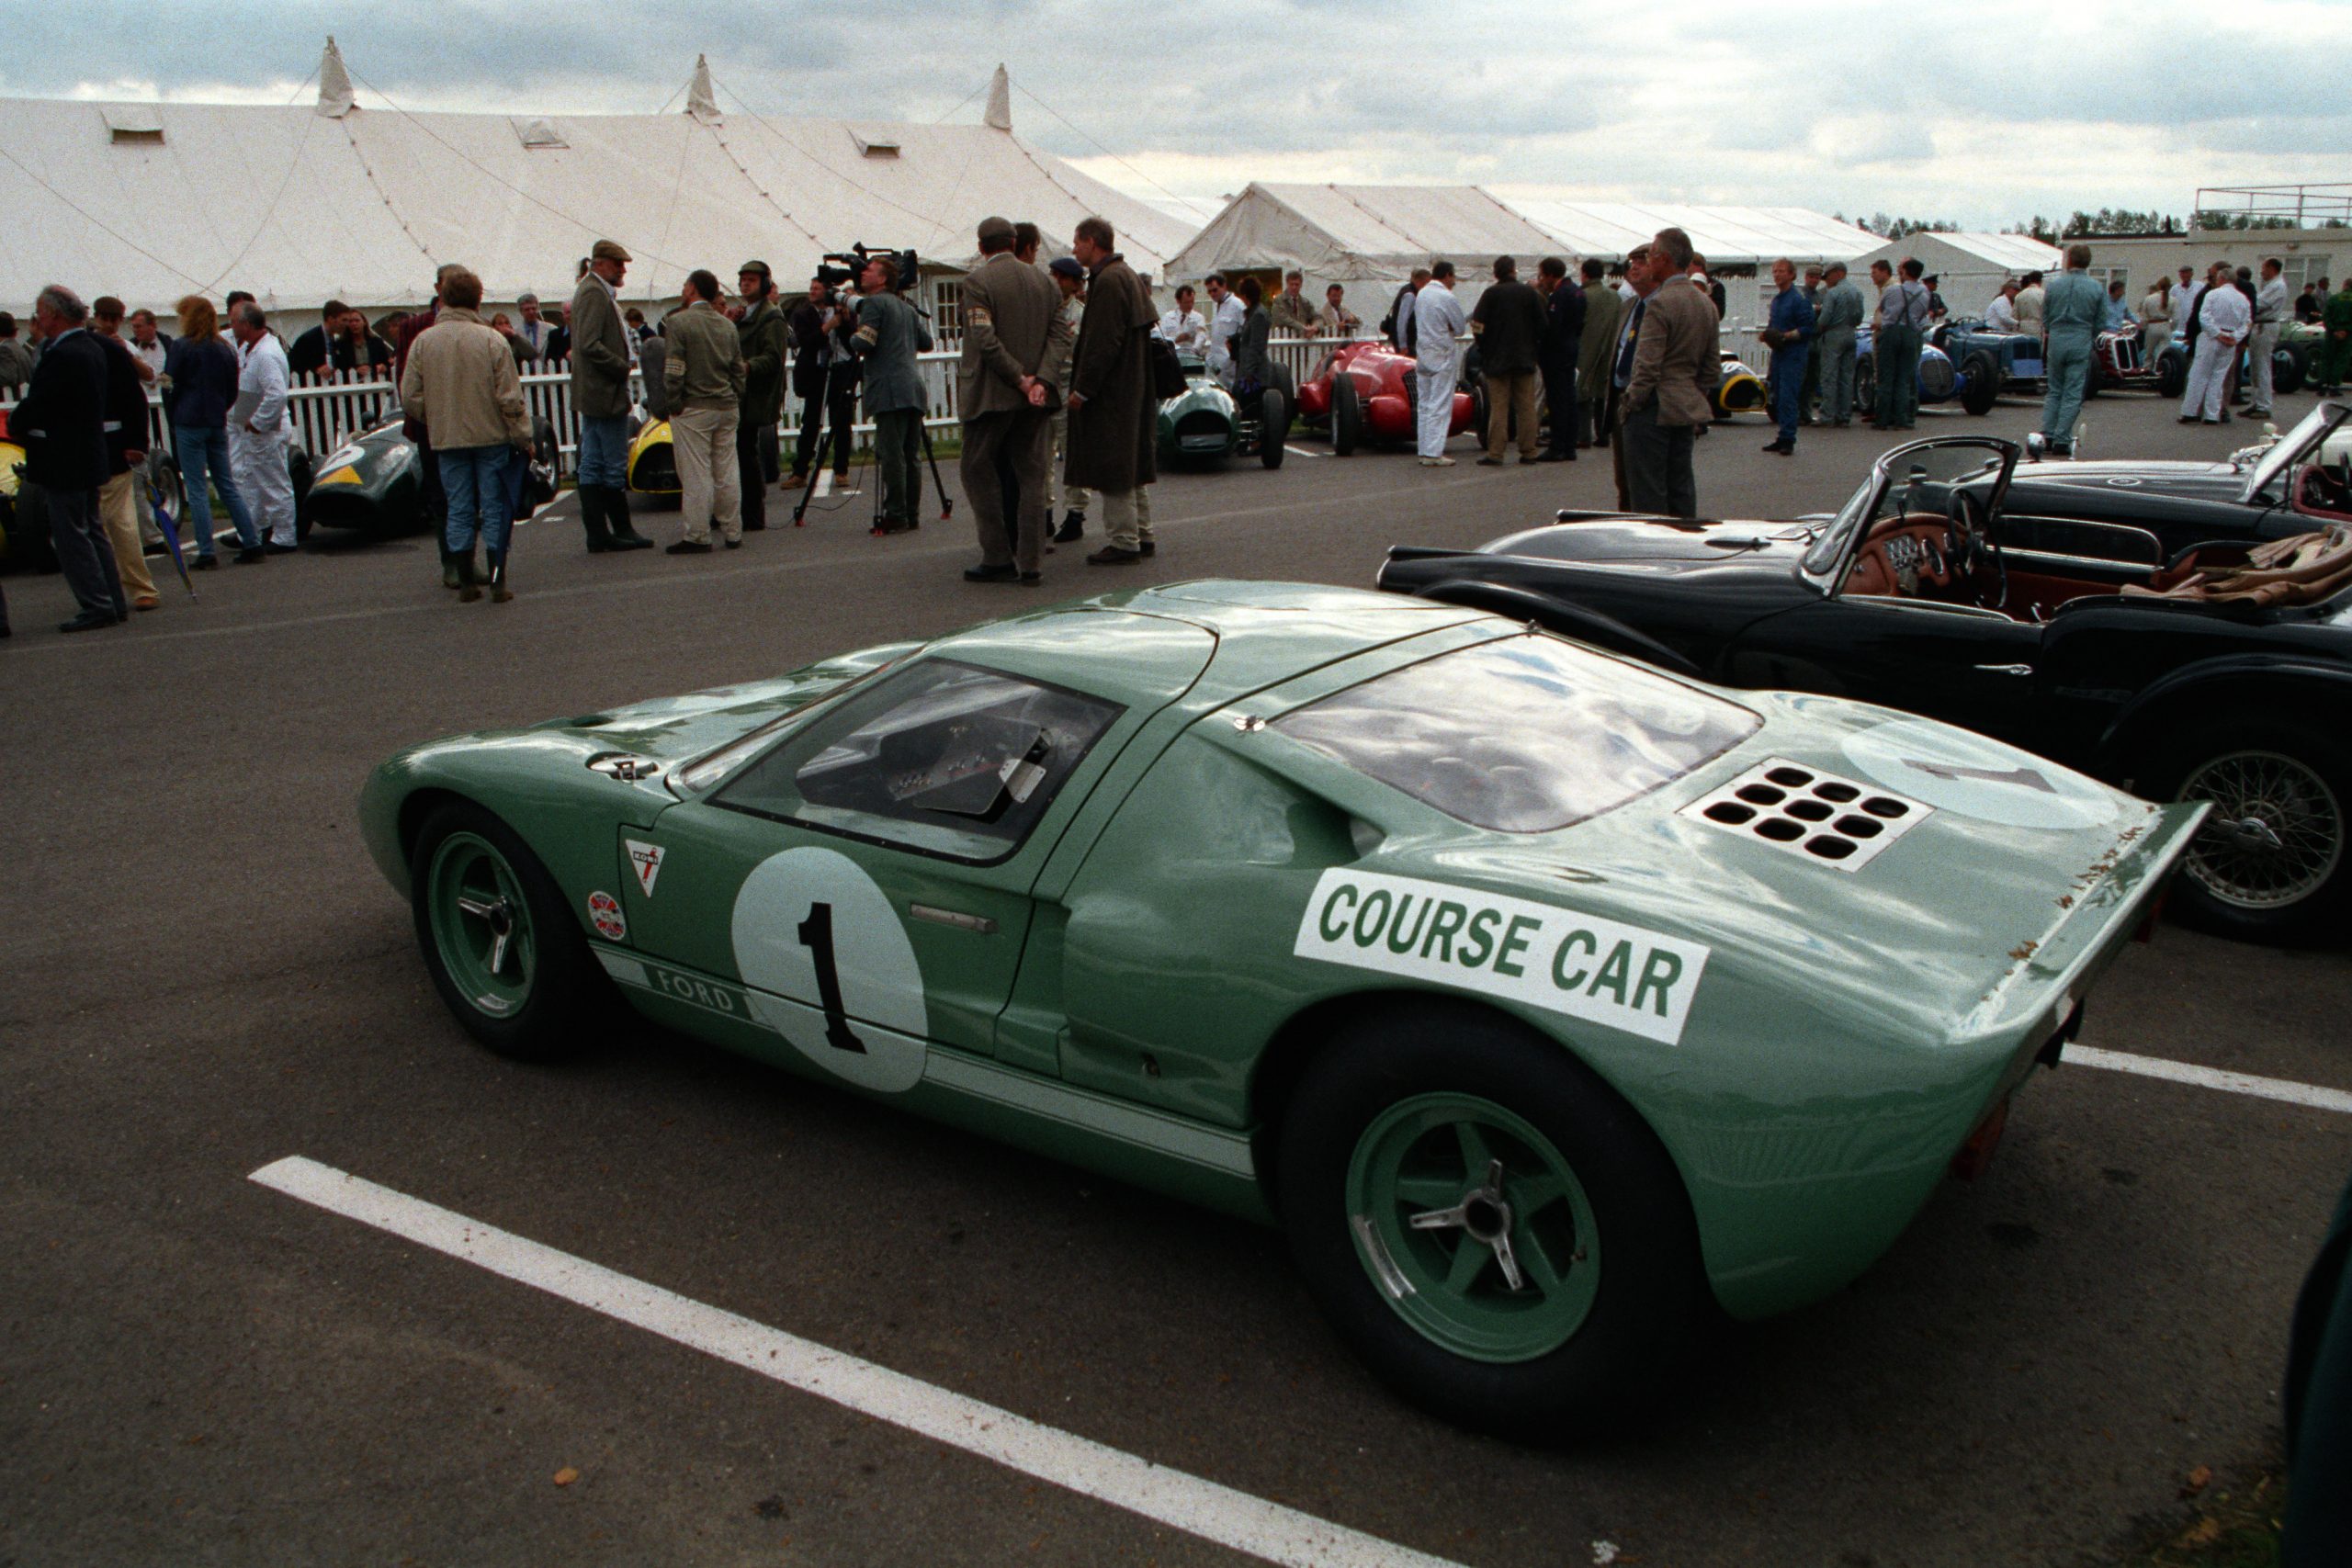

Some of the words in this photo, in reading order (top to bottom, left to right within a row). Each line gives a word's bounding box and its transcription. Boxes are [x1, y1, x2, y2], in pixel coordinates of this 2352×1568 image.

[657, 970, 733, 1010] FORD
[797, 901, 867, 1055] 1
[1319, 884, 1543, 977] COURSE
[1551, 930, 1682, 1018] CAR
